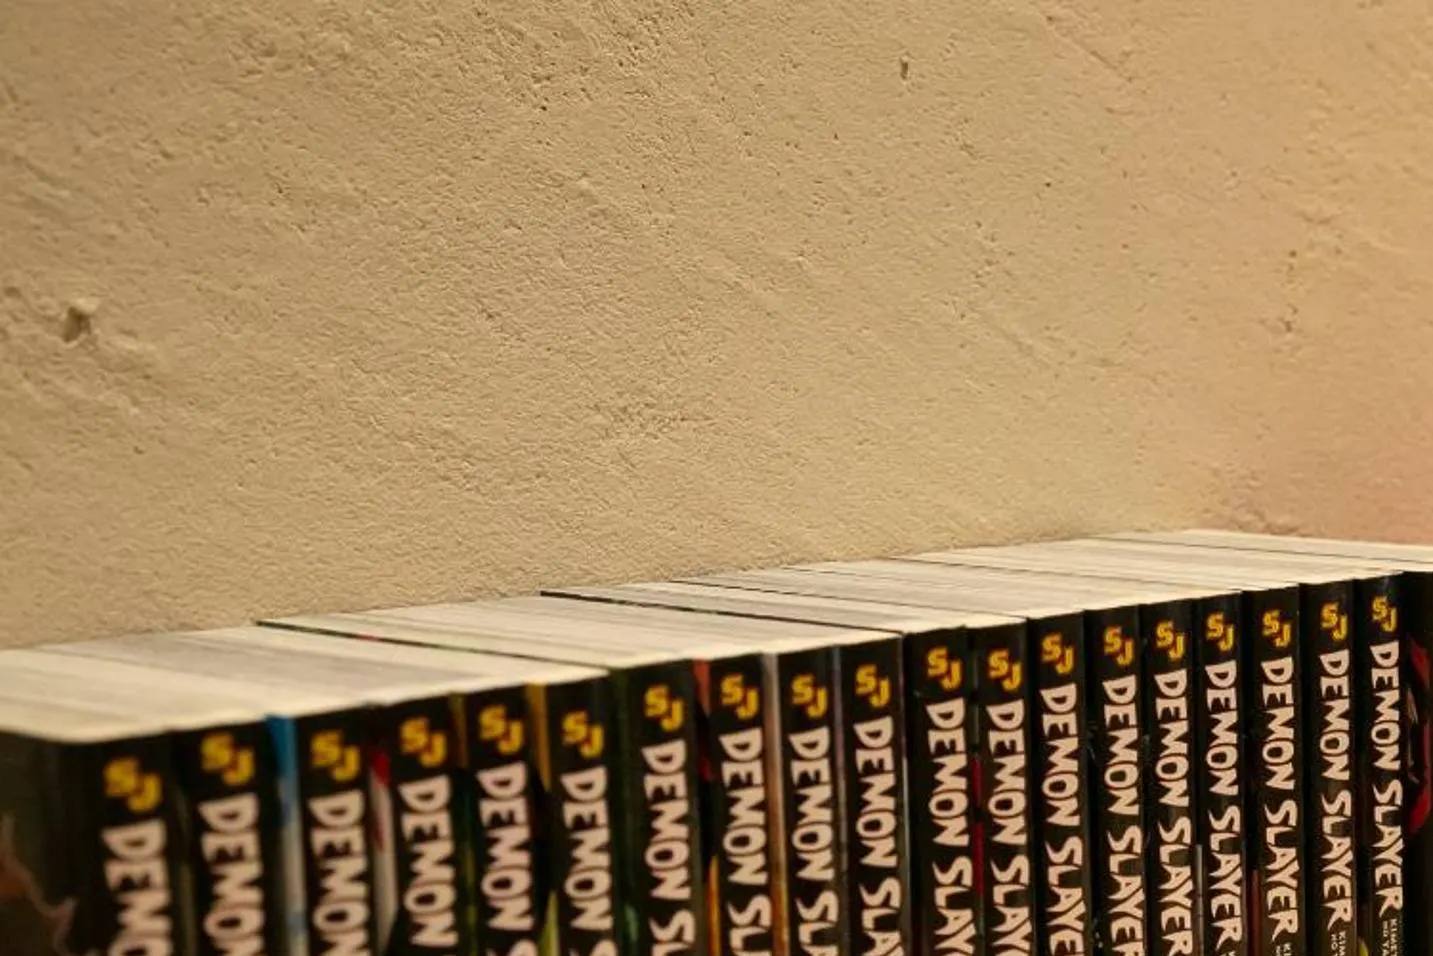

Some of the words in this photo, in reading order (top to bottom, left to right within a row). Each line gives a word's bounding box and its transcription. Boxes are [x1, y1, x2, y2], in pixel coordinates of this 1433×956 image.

[927, 647, 962, 691] SJ
[988, 649, 1021, 691] SJ
[1042, 633, 1074, 674] SJ
[1103, 626, 1134, 666] SJ
[1156, 621, 1185, 660] SJ
[1206, 611, 1234, 652] SJ
[1263, 610, 1290, 648] SJ
[1321, 603, 1348, 641] SJ
[1372, 596, 1397, 633] SJ
[402, 718, 447, 766] SJ
[480, 705, 523, 754] SJ
[562, 711, 604, 759] SJ
[645, 685, 684, 731] SJ
[721, 675, 759, 718] SJ
[792, 675, 827, 718] SJ
[855, 664, 891, 707] SJ
[1102, 674, 1139, 815] DEMON
[1154, 668, 1189, 807] DEMON
[1204, 660, 1238, 796] DEMON
[1260, 656, 1294, 790] DEMON
[1319, 649, 1350, 781] DEMON
[1369, 641, 1400, 771] DEMON
[202, 733, 254, 785] SJ
[311, 731, 361, 780] SJ
[641, 739, 691, 899] DEMON
[719, 728, 768, 885] DEMON
[788, 726, 833, 881] DEMON
[854, 716, 898, 868] DEMON
[926, 698, 969, 847] DEMON
[986, 700, 1027, 845] DEMON
[1040, 683, 1080, 826] DEMON
[400, 775, 457, 947] DEMON
[478, 762, 534, 931] DEMON
[561, 766, 613, 931] DEMON
[1209, 805, 1242, 950] SLAYER
[1264, 799, 1299, 941] SLAYER
[1321, 789, 1352, 931] SLAYER
[1372, 780, 1403, 917] SLAYER
